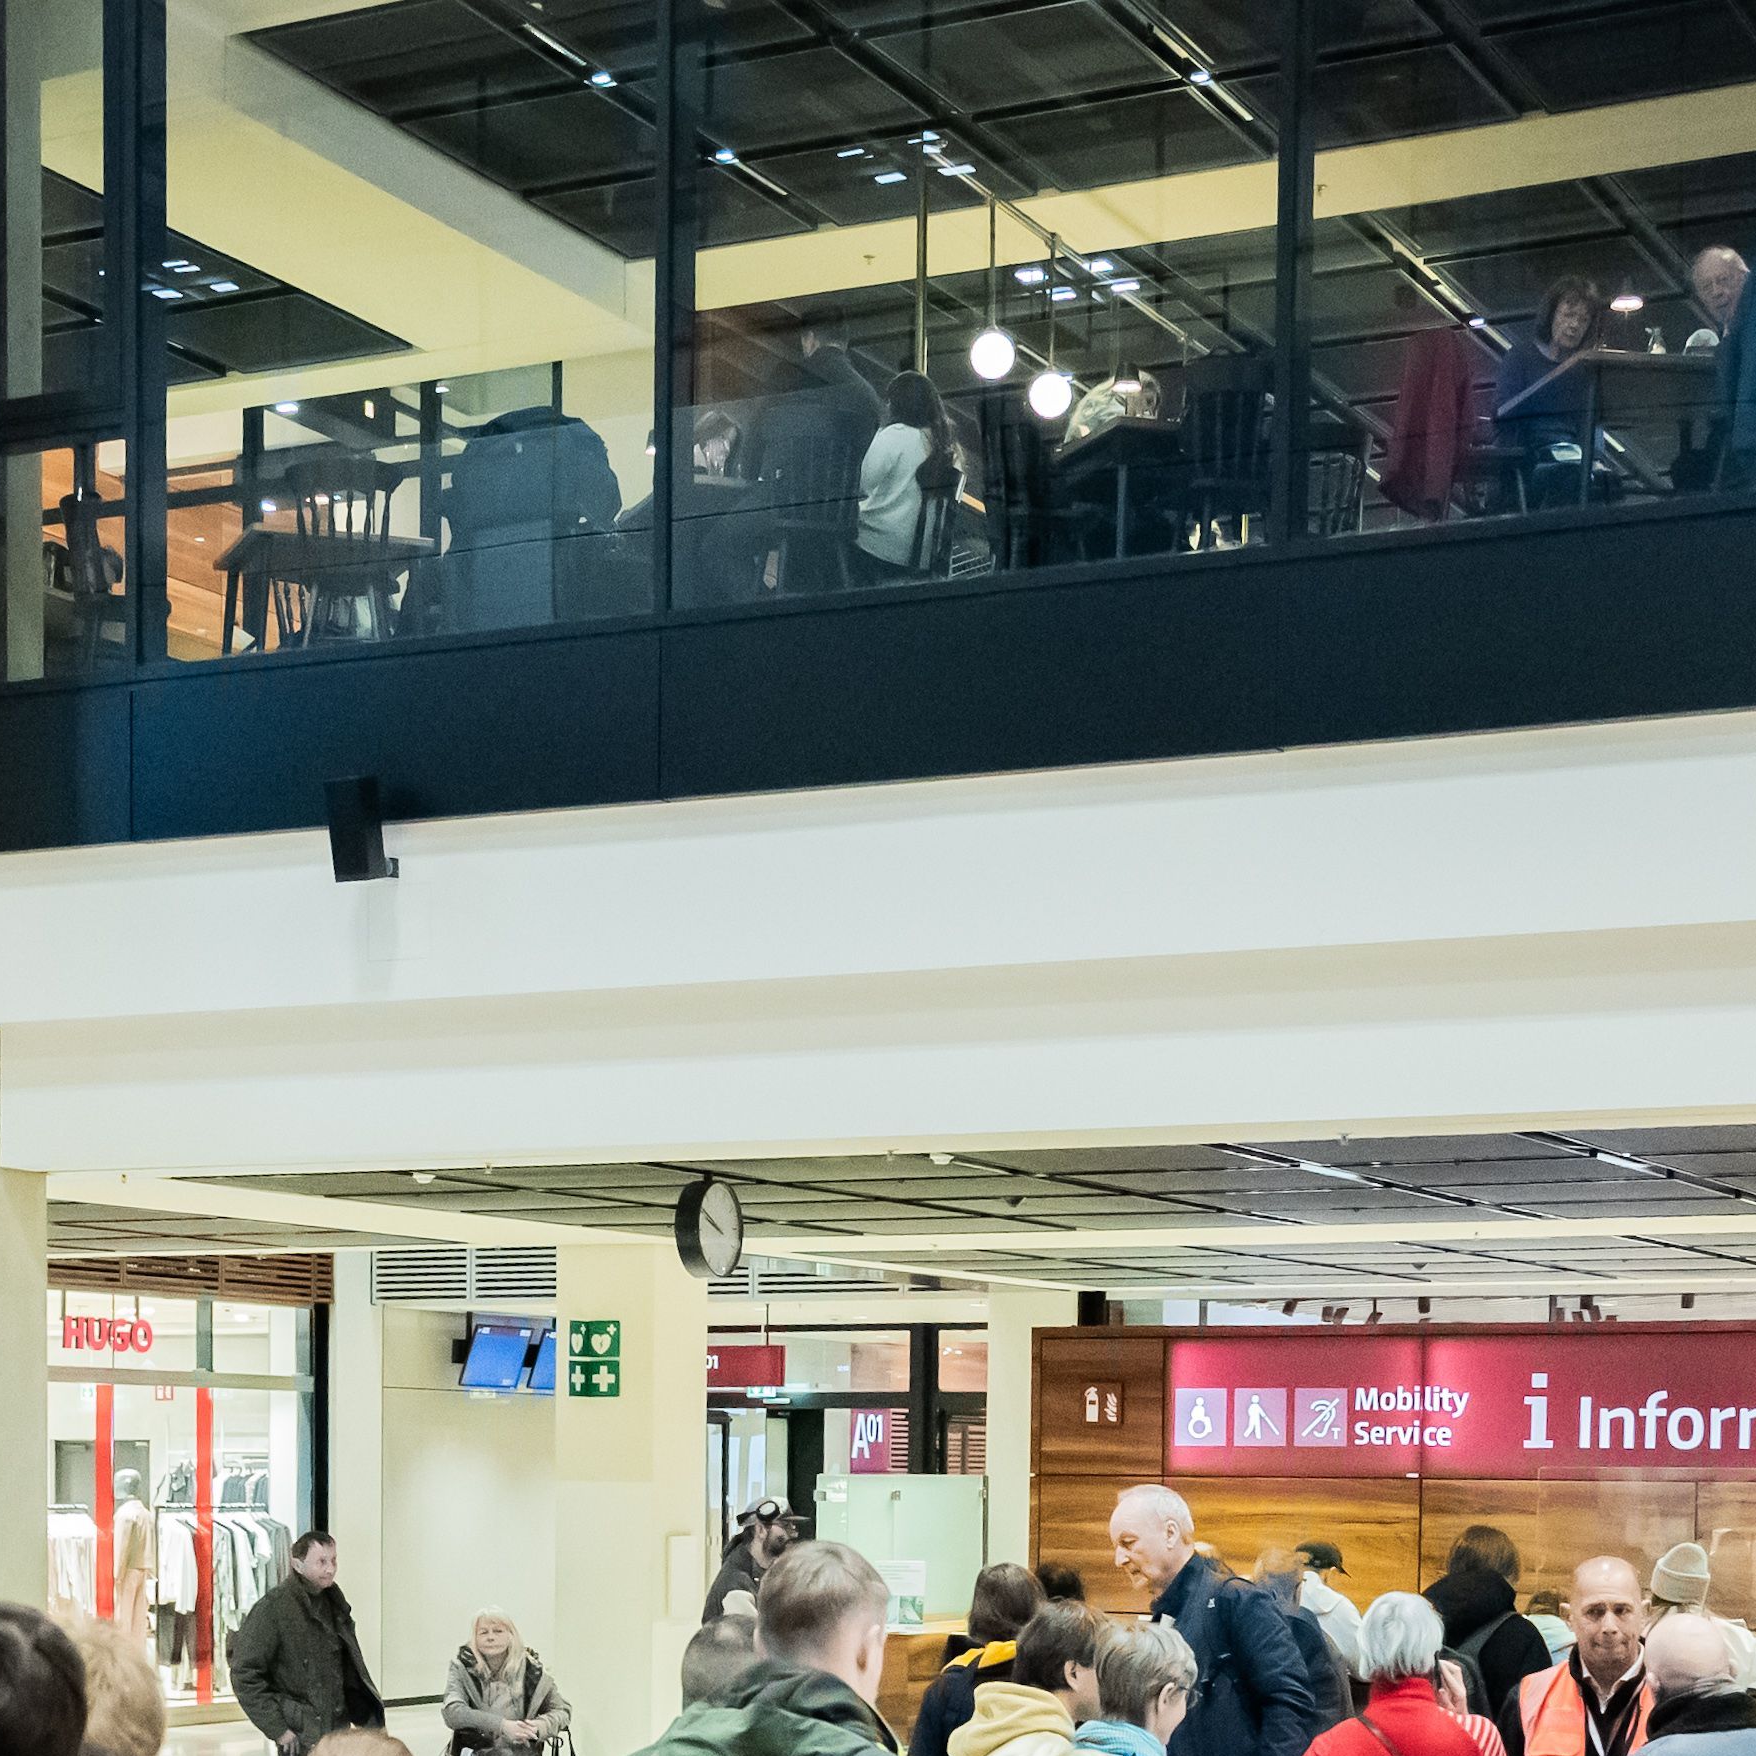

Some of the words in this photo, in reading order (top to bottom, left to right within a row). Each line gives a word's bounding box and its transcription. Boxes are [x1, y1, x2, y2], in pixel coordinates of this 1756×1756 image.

[63, 1316, 153, 1353] HUGO
[1354, 1385, 1470, 1419] Mobility
[1354, 1419, 1453, 1447] Service
